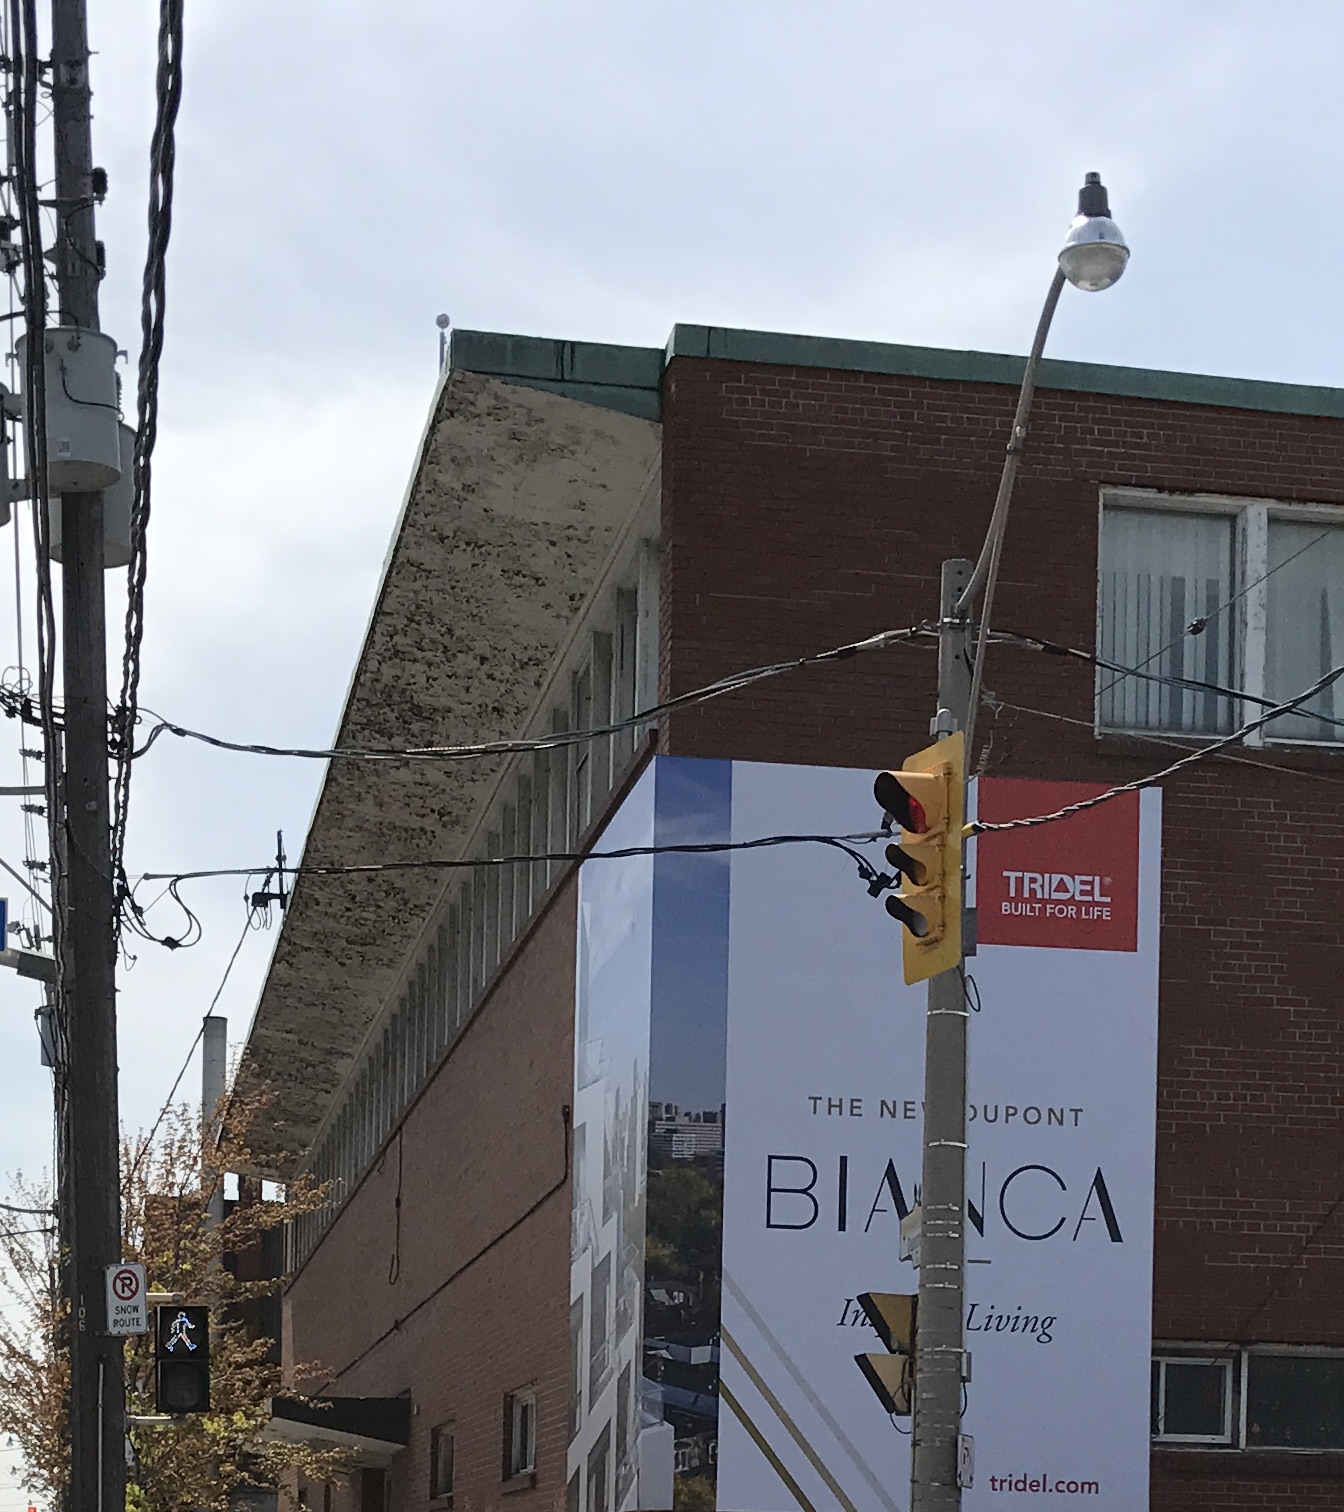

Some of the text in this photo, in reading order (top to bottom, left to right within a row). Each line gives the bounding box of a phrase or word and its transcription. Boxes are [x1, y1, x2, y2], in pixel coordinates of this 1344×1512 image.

[1002, 870, 1111, 903] TRIDEL
[1001, 902, 1112, 920] BUILT FOR LIFE
[808, 1096, 863, 1118] THE
[879, 1100, 926, 1120] NE
[114, 1304, 140, 1315] SNOW
[112, 1317, 142, 1328] ROUTE
[966, 1302, 1058, 1344] Living
[988, 1472, 1100, 1495] tridel.com
